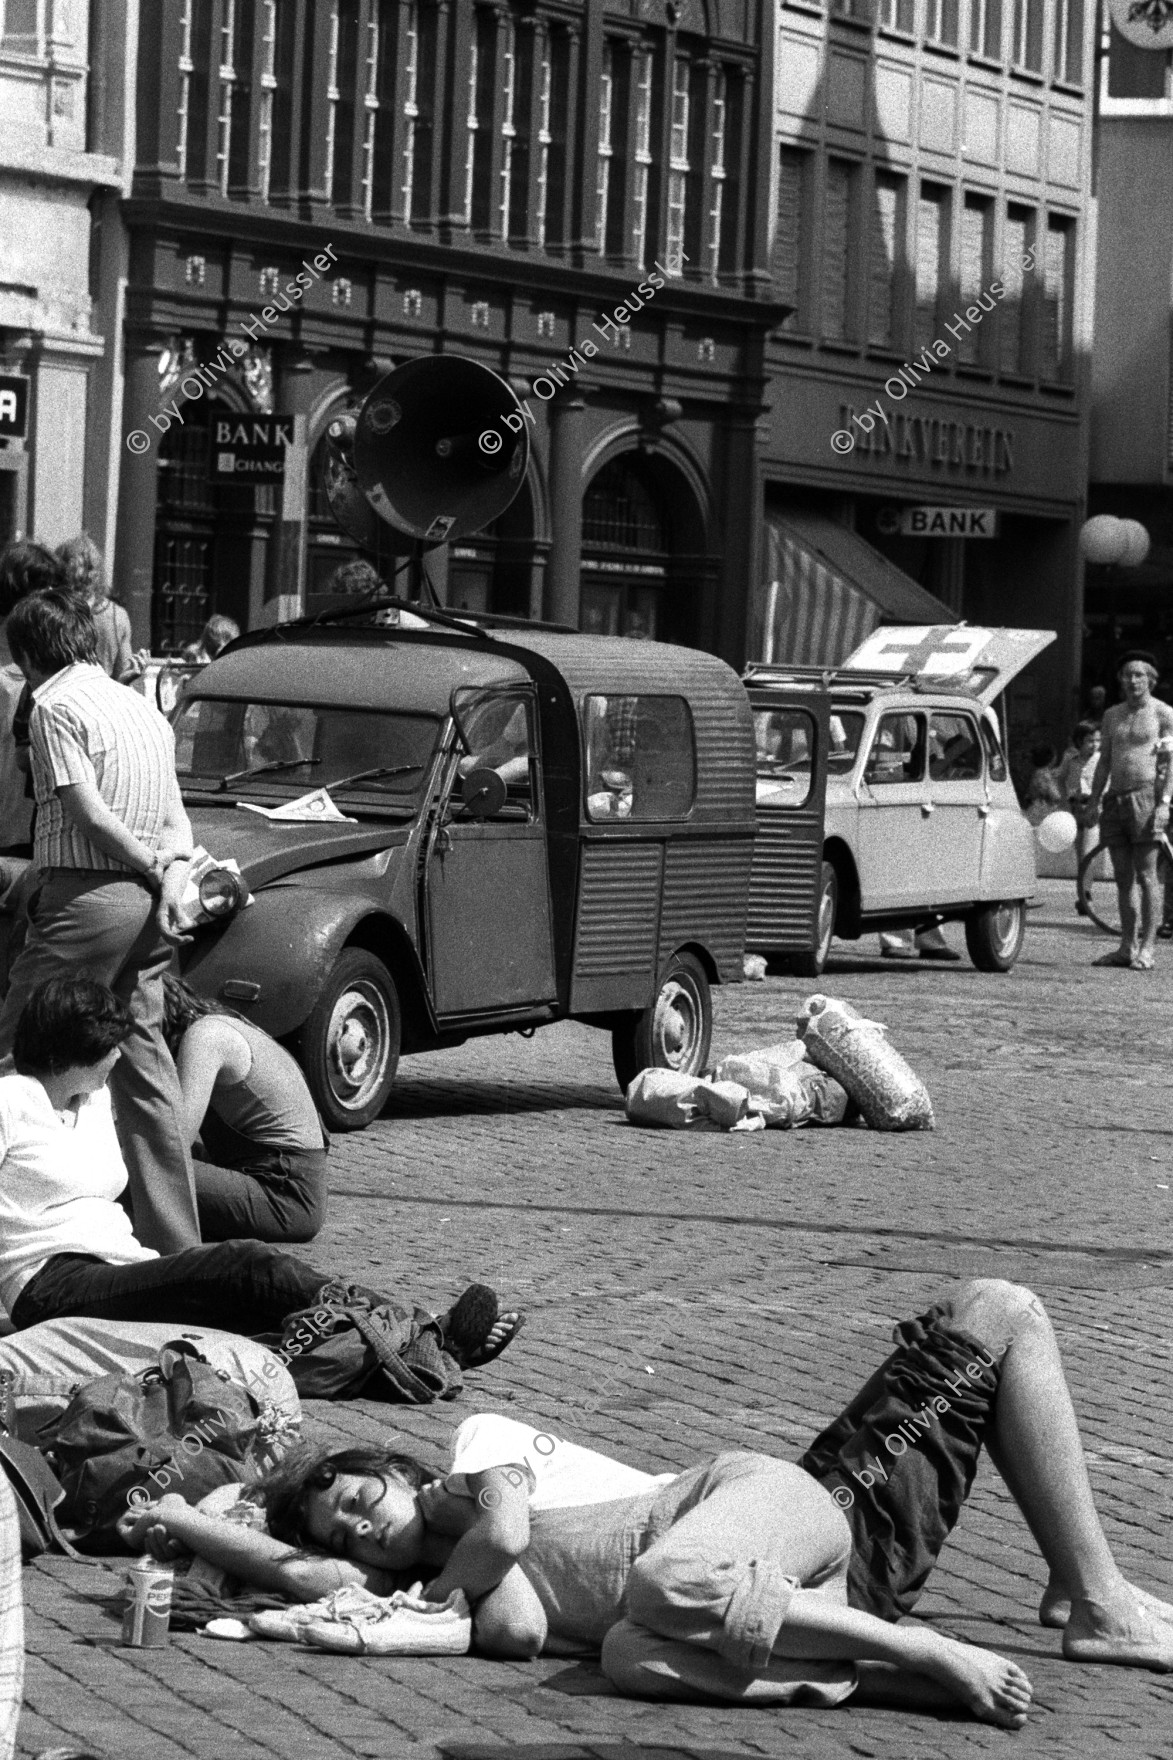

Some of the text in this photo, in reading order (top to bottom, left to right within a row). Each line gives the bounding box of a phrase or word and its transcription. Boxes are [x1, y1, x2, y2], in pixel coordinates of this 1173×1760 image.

[216, 421, 293, 447] BANK
[235, 459, 284, 474] CHANG
[911, 511, 986, 534] BANK
